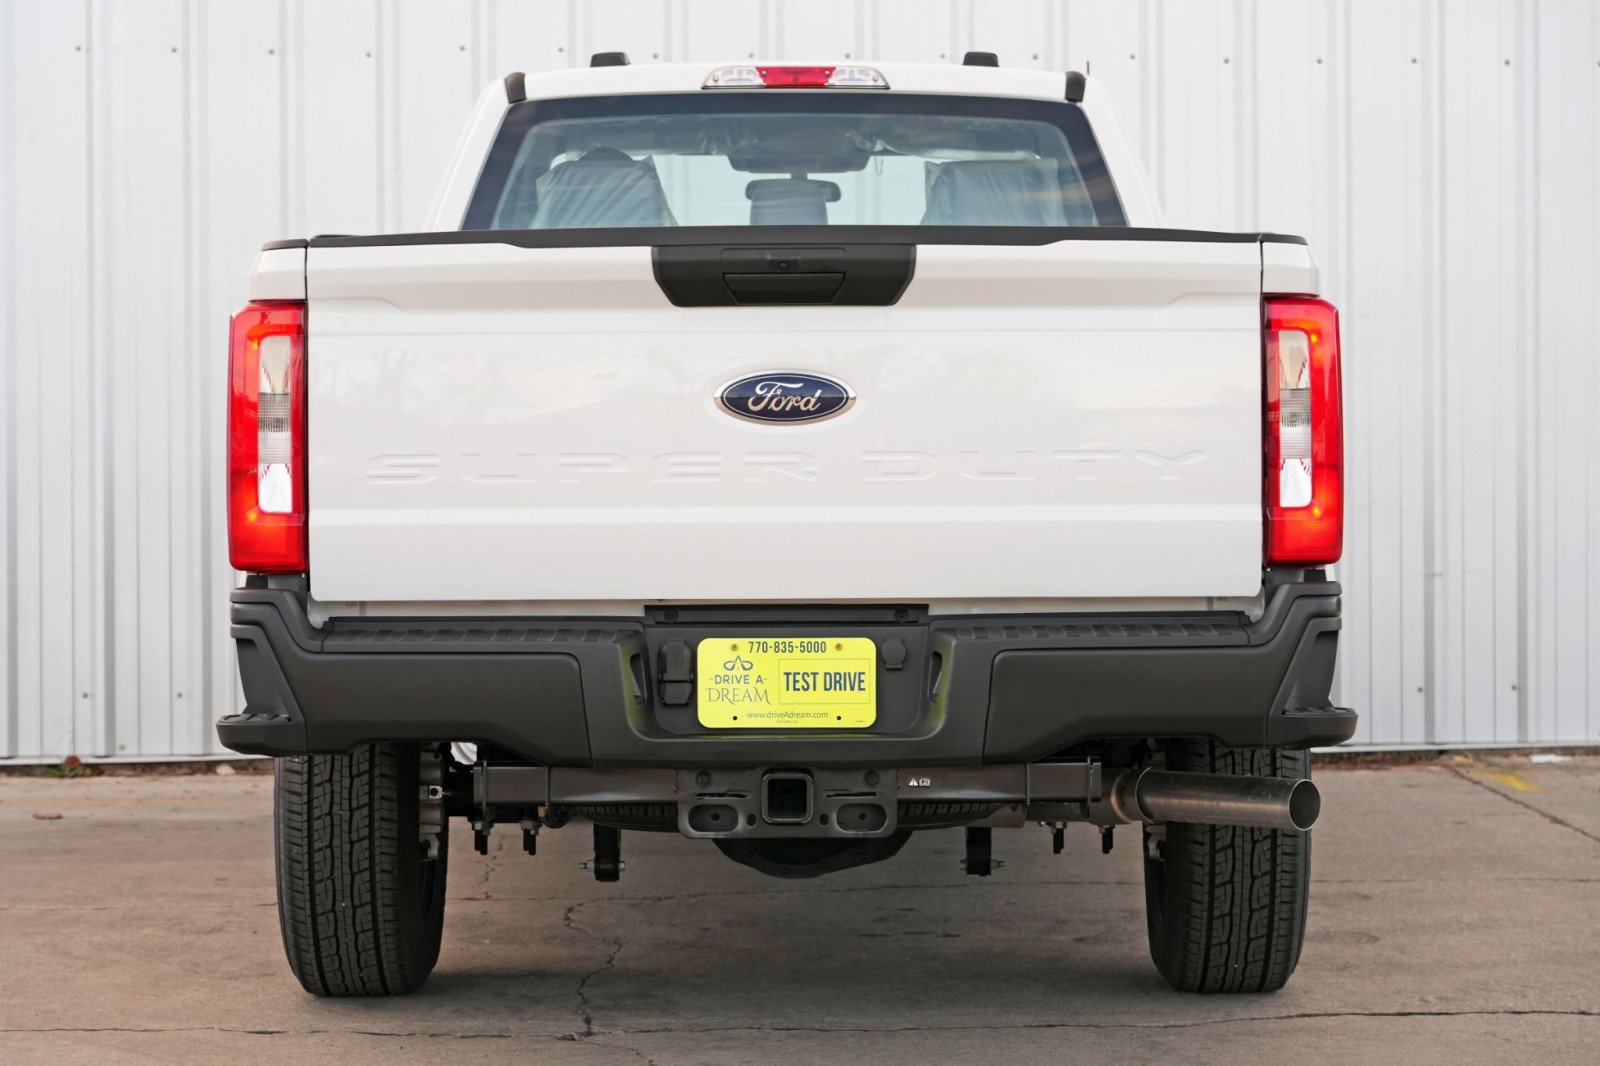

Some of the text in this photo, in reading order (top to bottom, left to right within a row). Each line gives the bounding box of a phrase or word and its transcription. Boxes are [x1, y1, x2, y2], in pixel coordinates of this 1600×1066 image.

[747, 381, 822, 411] Ford
[366, 450, 1207, 484] SUPER DUTY
[748, 641, 827, 654] 770-835-5000
[714, 674, 765, 685] DRIVE A
[783, 671, 866, 692] TEST DRIVE
[707, 686, 772, 705] DREAM
[746, 711, 829, 719] www.driveAdream.com
